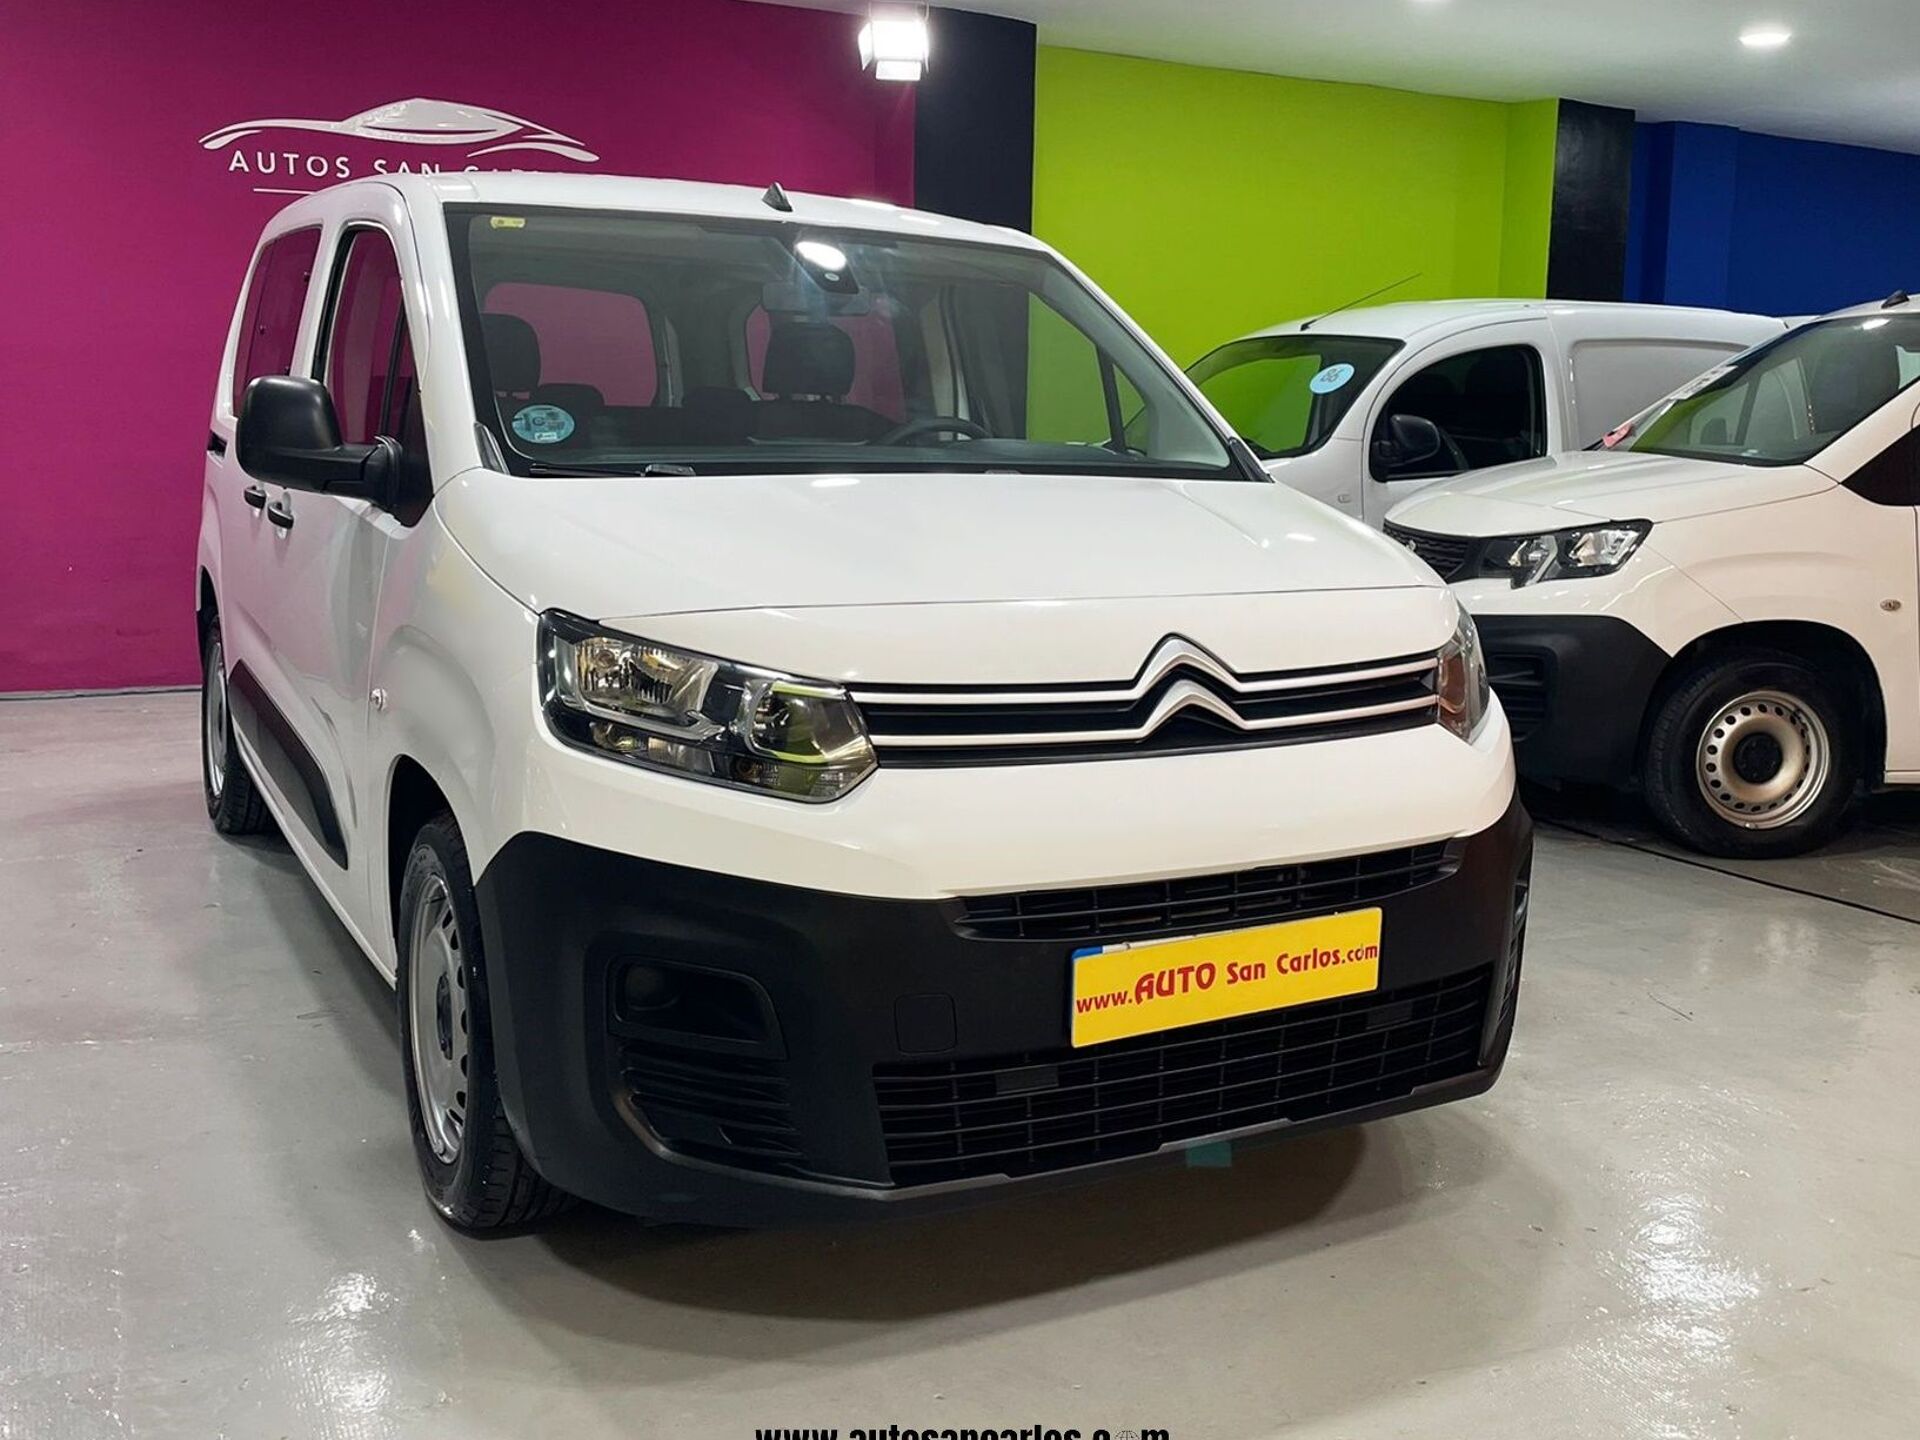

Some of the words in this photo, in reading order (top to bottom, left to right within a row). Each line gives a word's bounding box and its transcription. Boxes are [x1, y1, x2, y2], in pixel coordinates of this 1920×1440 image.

[228, 150, 350, 178] AUTOS
[1075, 961, 1217, 1014] www.AUTO
[1226, 961, 1266, 985] San
[1276, 945, 1379, 975] Carlos.com
